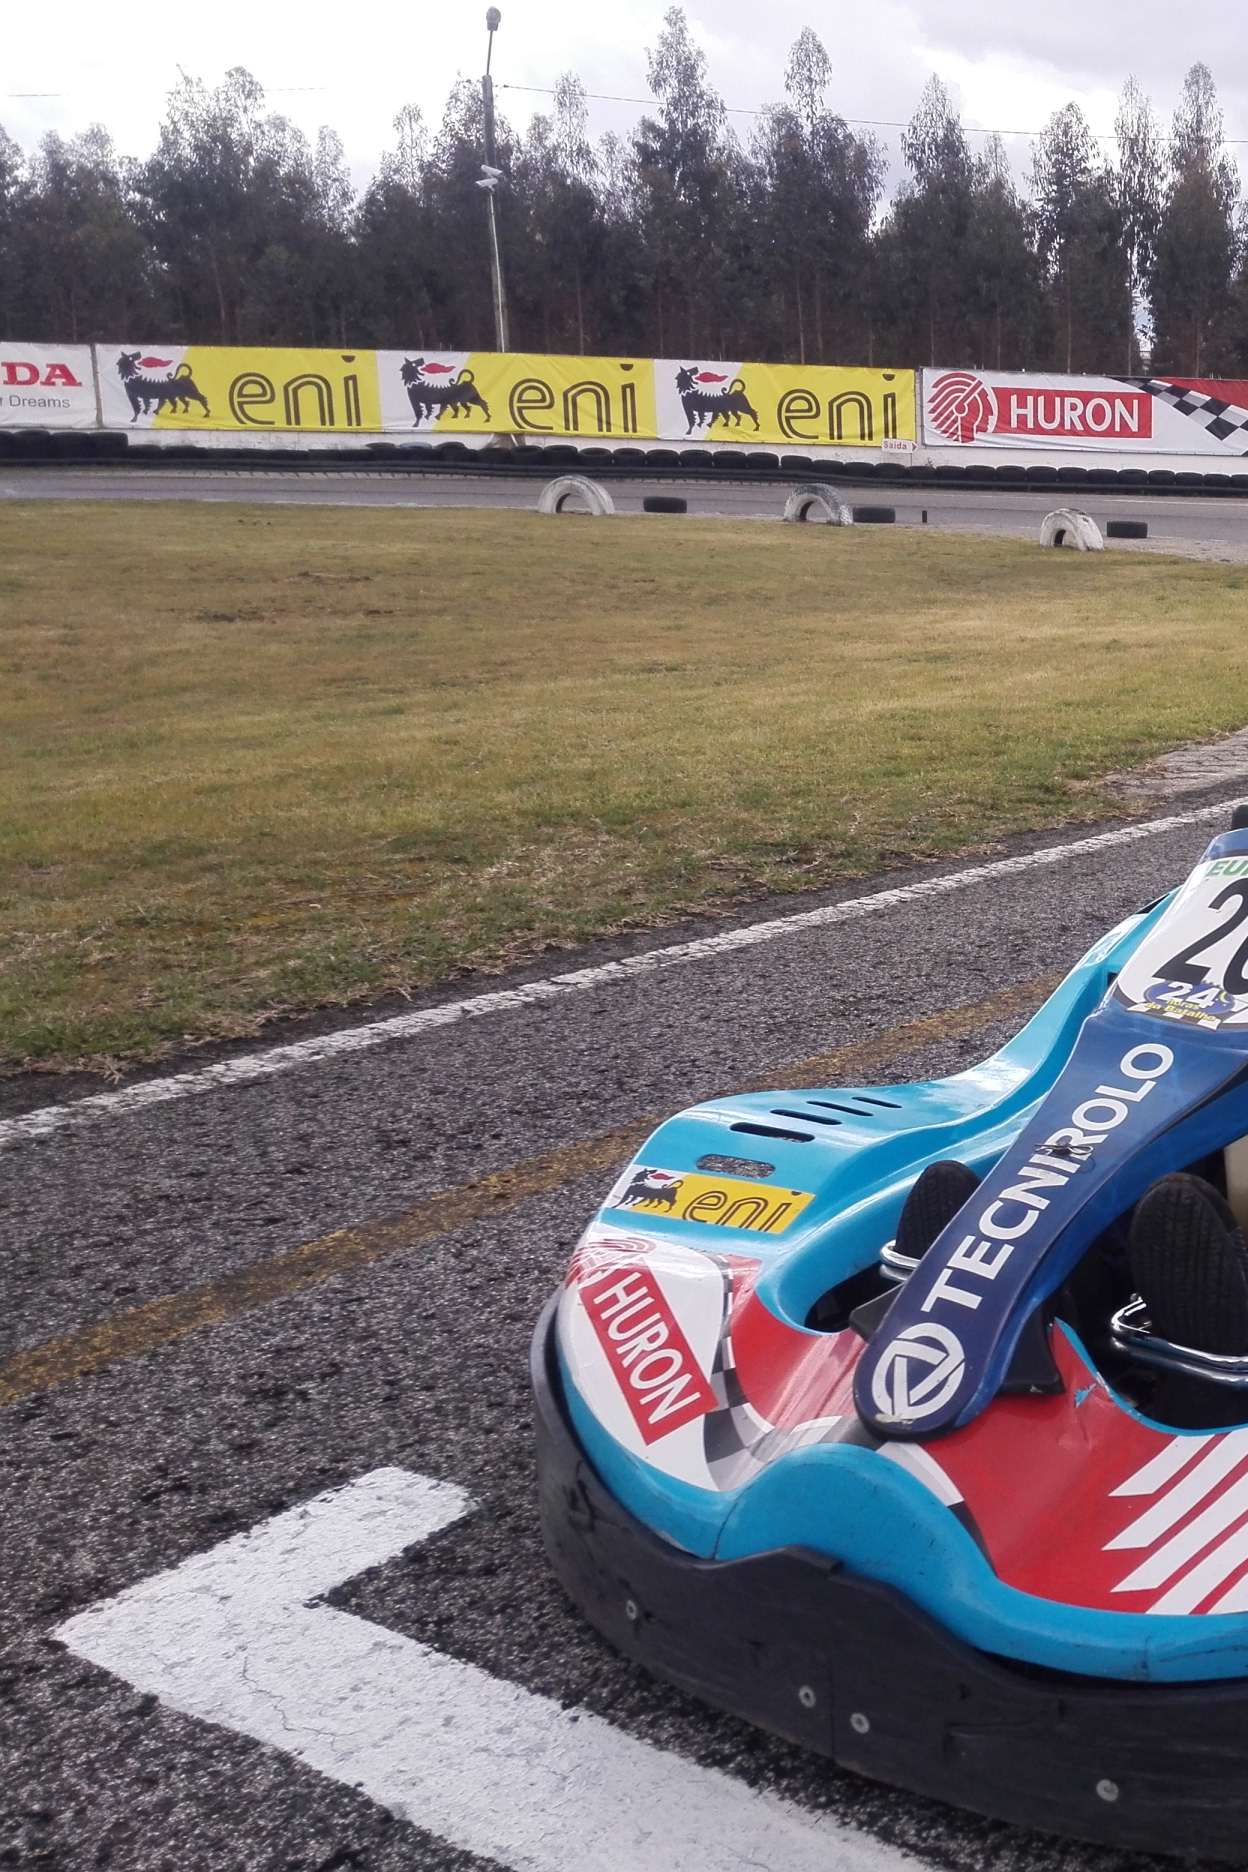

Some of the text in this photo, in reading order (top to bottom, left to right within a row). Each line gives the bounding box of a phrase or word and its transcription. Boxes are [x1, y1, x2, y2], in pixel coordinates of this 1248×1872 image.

[9, 395, 71, 408] Dreams
[228, 355, 362, 427] eni
[509, 363, 637, 433] eni
[777, 373, 897, 440] eni
[1009, 396, 1141, 433] HURON
[1156, 981, 1221, 1008] 24
[682, 1189, 803, 1233] eni
[920, 1043, 1175, 1312] TECNIROLO
[593, 1272, 701, 1424] HURON
